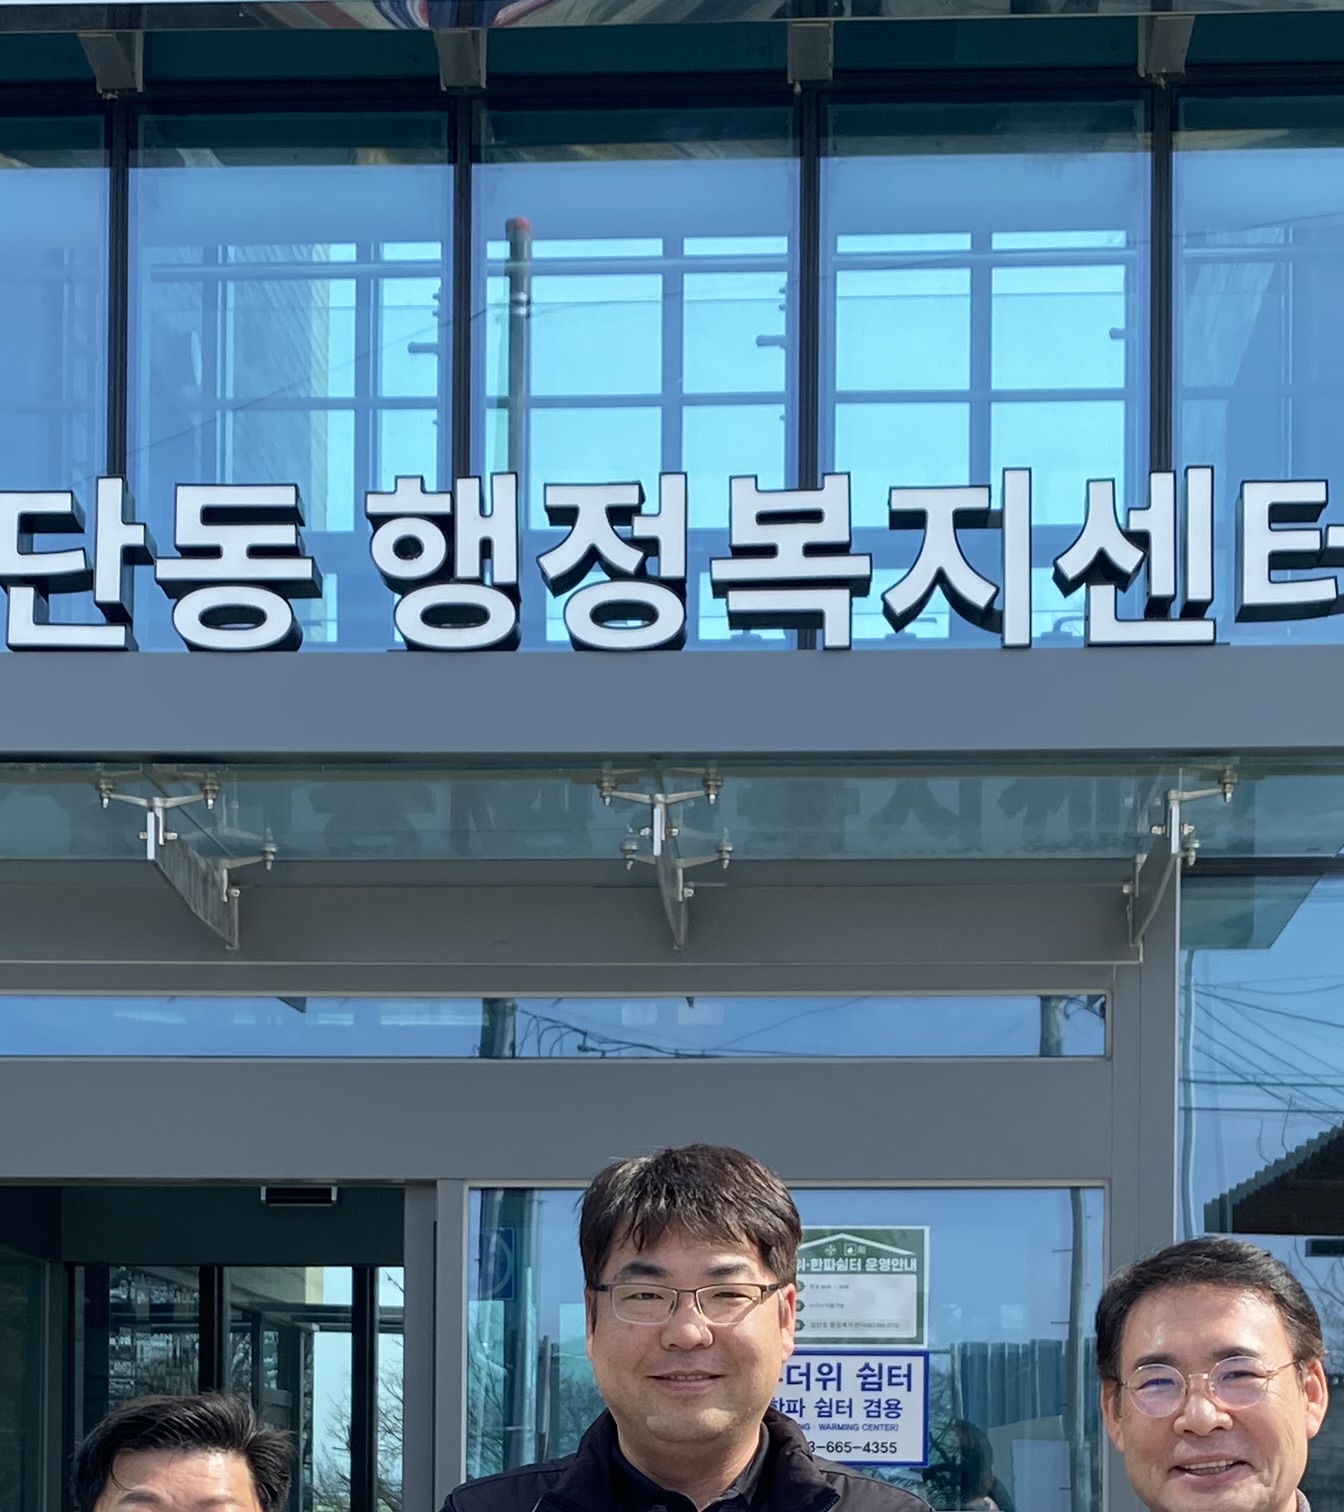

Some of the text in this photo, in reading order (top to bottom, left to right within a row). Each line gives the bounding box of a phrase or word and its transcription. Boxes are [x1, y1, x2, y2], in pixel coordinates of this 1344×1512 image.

[865, 1258, 917, 1272] 운영안내
[779, 1362, 912, 1392] 더위 쉼터
[814, 1398, 852, 1418] 쉼터
[863, 1398, 903, 1419] 겸용
